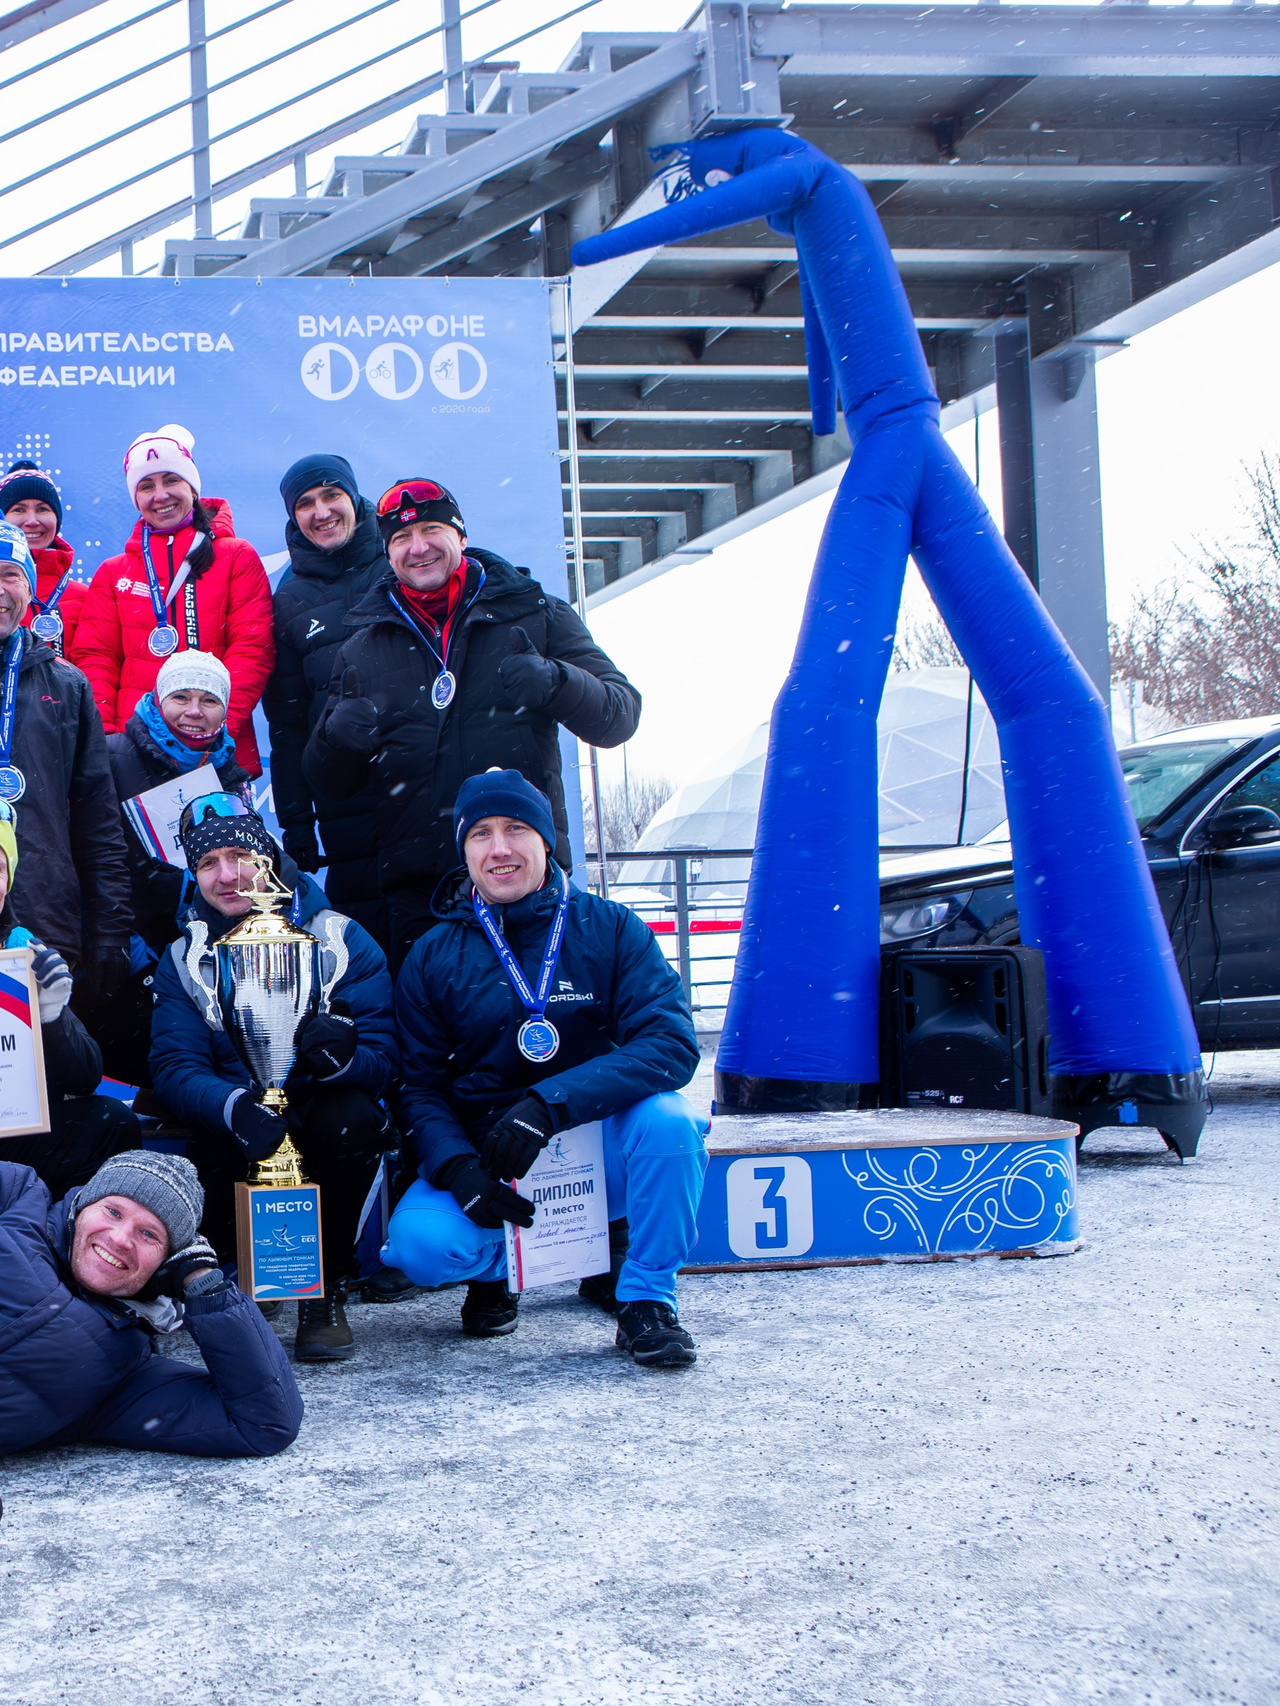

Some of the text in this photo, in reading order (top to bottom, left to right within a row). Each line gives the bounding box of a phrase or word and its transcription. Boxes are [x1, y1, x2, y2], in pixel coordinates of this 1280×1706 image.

[298, 314, 486, 337] ВМАРАФОНЕ
[440, 405, 465, 413] 2020
[468, 406, 490, 414] года
[547, 993, 593, 1002] ORDSKI
[513, 1119, 544, 1137] NORDSKI
[532, 1179, 594, 1205] ДИПЛОМ
[256, 1201, 313, 1213] 1 МЕСТО
[463, 1194, 481, 1212] NORDSK
[543, 1203, 584, 1217] 1 место
[753, 1166, 788, 1250] 3
[540, 1215, 587, 1229] НАГРАЖДАЕТСЯ
